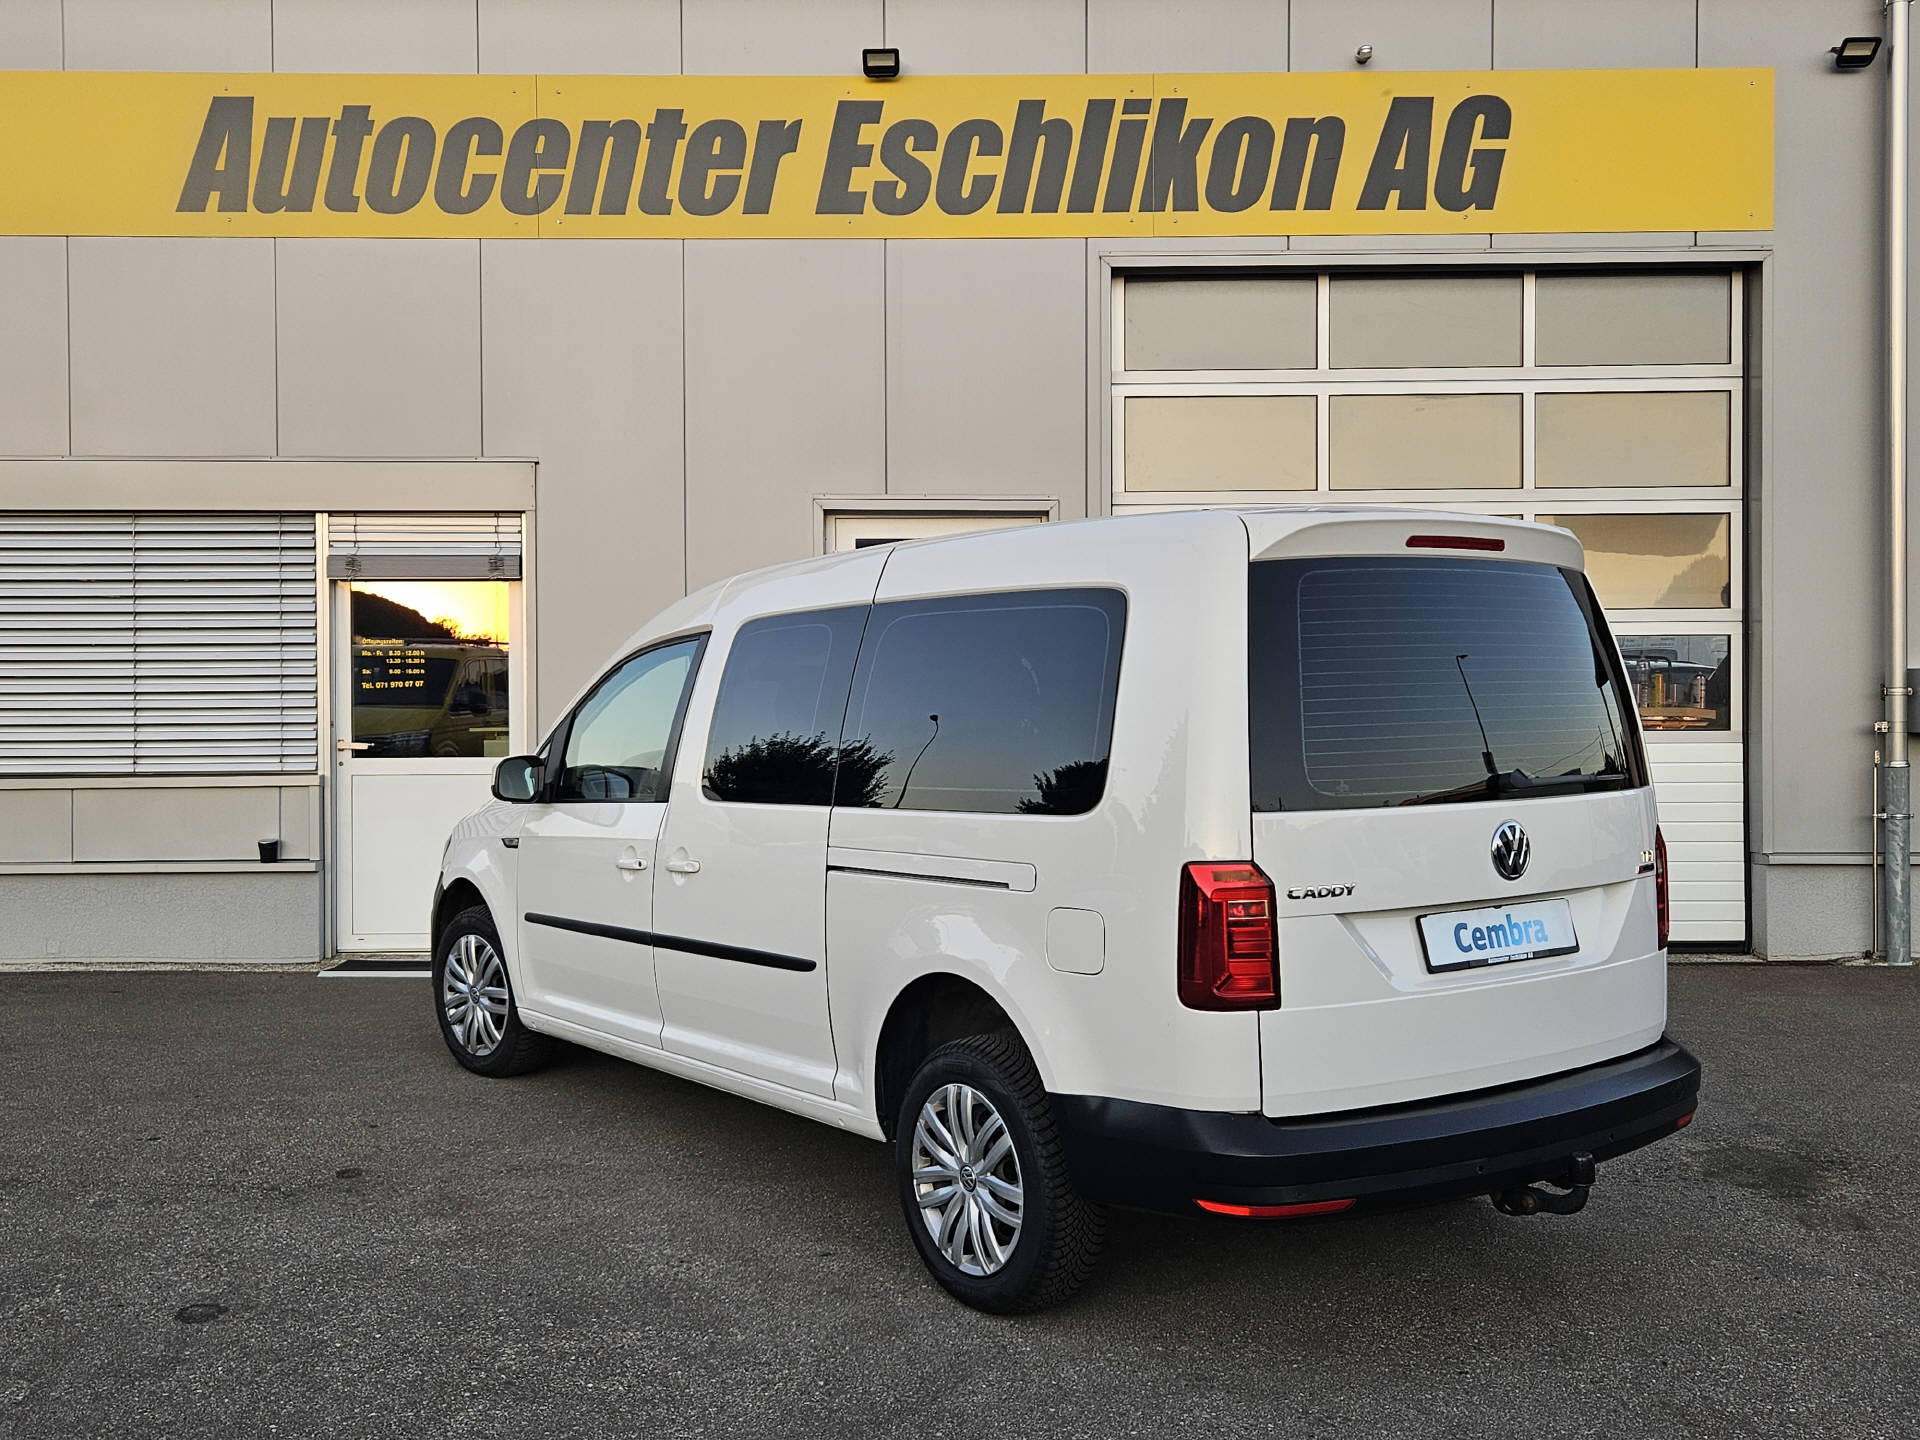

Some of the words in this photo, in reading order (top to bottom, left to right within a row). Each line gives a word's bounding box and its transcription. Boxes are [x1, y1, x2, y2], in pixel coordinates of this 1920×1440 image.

[177, 97, 803, 216] Autocenter
[816, 98, 1346, 216] Eschlikon
[1357, 95, 1512, 213] AG
[375, 681, 388, 689] 071
[404, 680, 414, 688] 07
[1287, 883, 1356, 900] CADDY
[1454, 914, 1548, 953] Cembra
